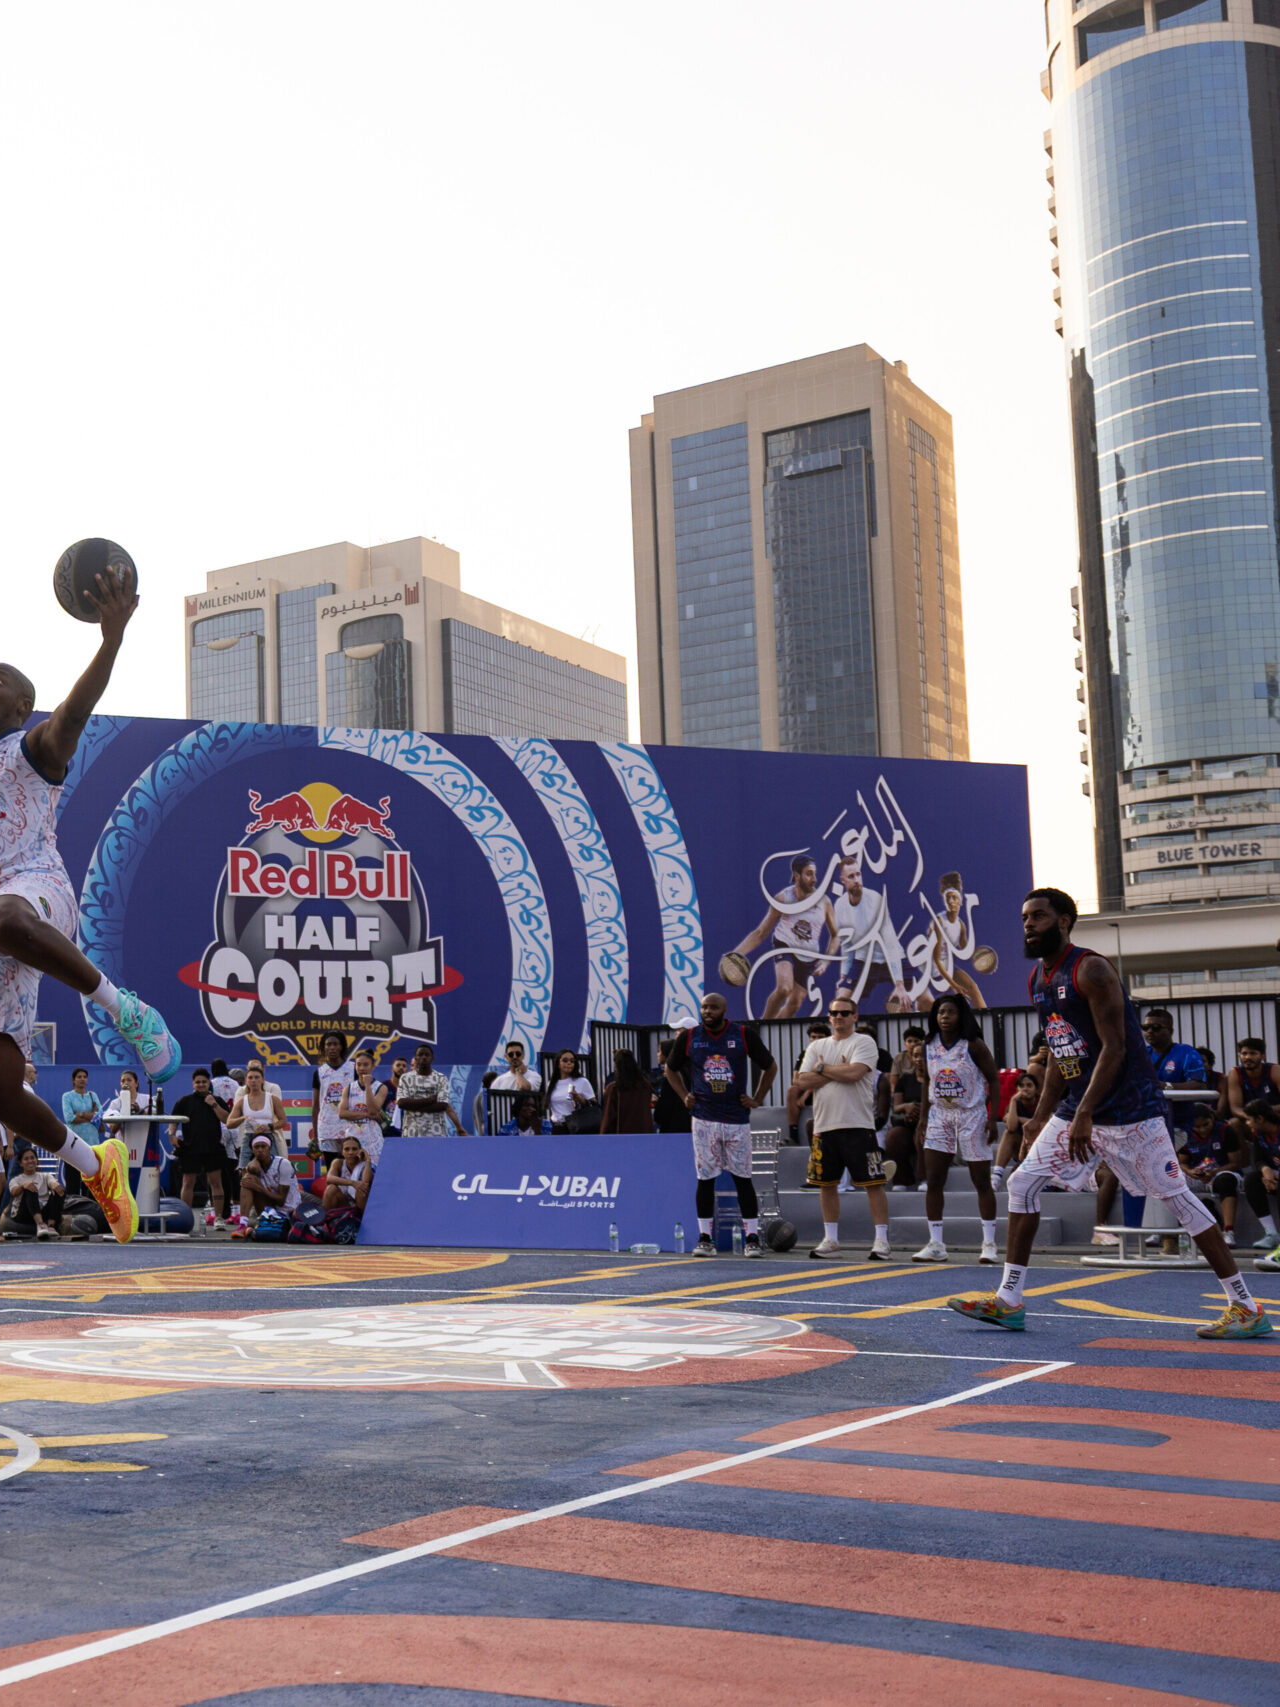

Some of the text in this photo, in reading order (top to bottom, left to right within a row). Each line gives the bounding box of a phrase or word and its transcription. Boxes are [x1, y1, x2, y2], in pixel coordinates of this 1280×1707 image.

[199, 588, 266, 610] MILLENNIUM
[321, 592, 403, 619] ميلينيوم
[1157, 842, 1262, 863] BLUE TOWER
[229, 849, 409, 899] Red Bull
[264, 914, 380, 951] HALF
[207, 947, 436, 1033] COURT
[256, 1020, 390, 1034] WORLD FINALS 2025
[577, 1200, 616, 1209] SPORTS
[104, 1319, 752, 1367] COURT
